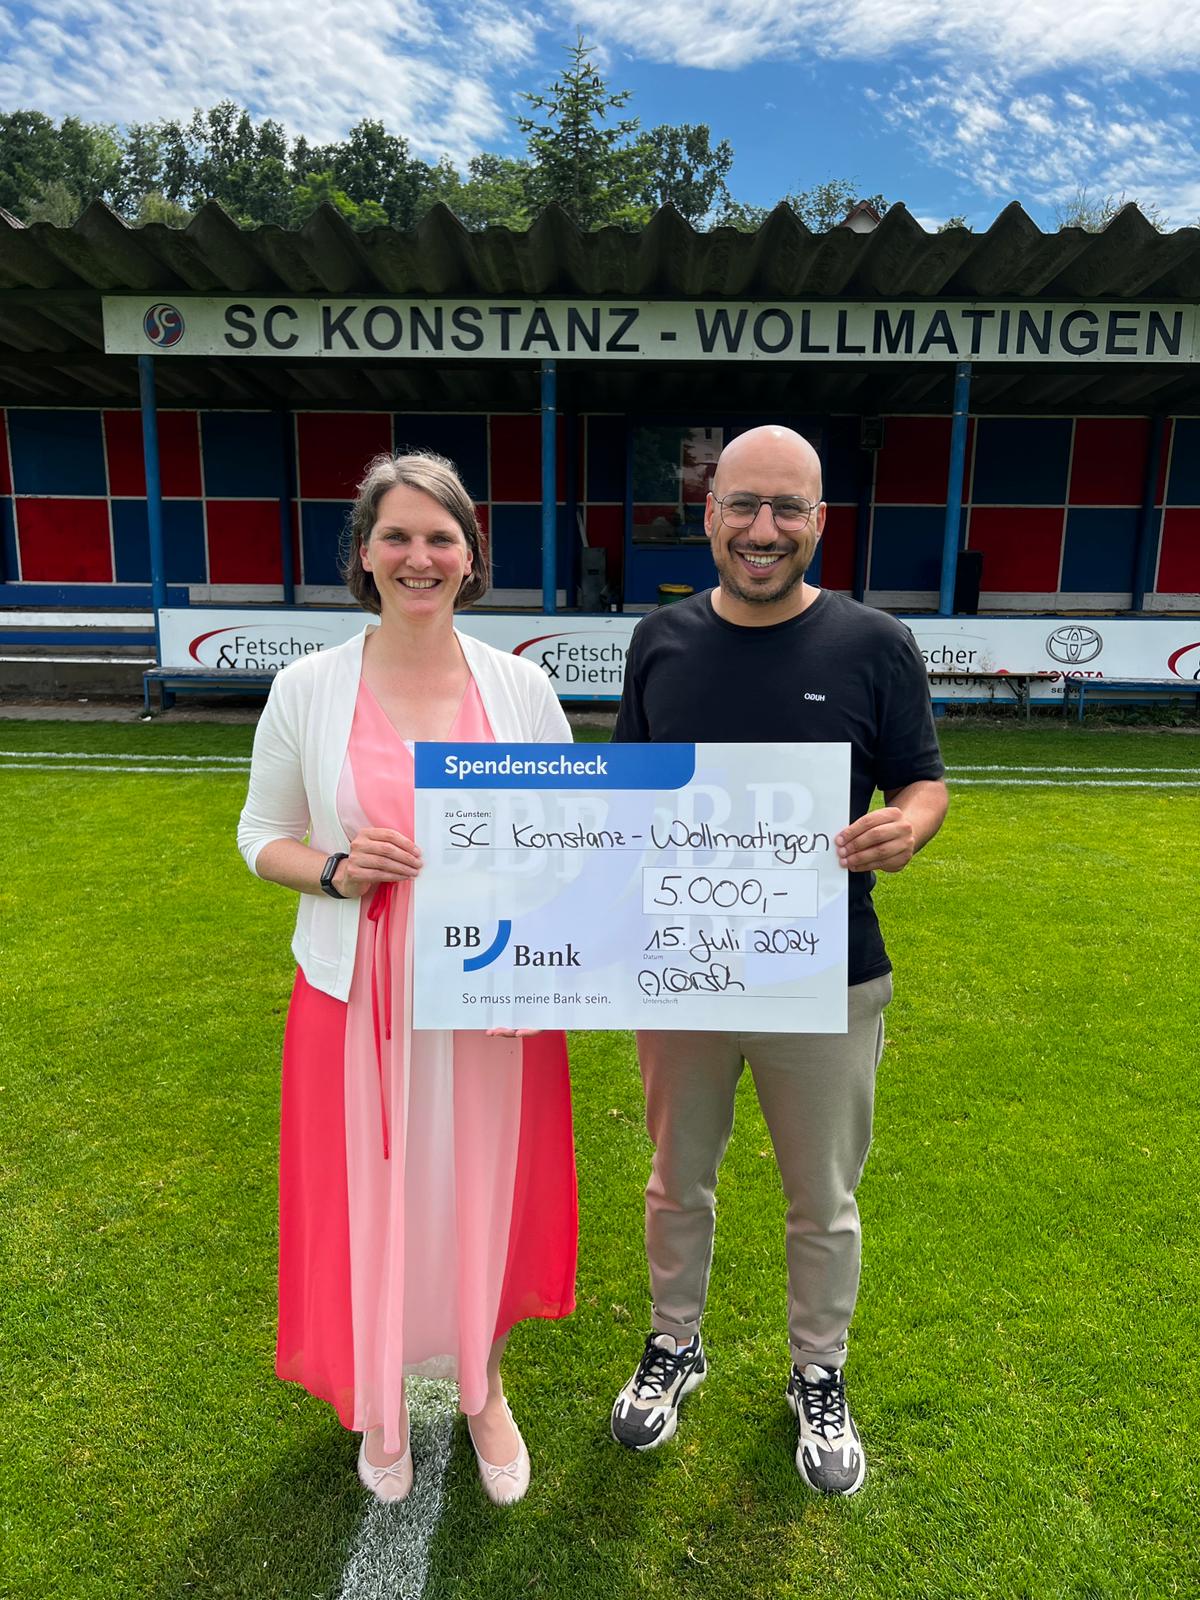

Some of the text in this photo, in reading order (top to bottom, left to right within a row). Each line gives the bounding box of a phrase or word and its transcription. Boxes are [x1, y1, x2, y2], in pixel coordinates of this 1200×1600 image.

[223, 303, 299, 350] SC
[323, 304, 641, 352] KONSTANZ
[695, 307, 1184, 356] WOLLMATINGEN
[235, 636, 324, 656] Fetscher
[557, 643, 629, 662] Fetsch
[920, 645, 977, 664] scher
[566, 665, 622, 683] Dietri
[444, 754, 608, 780] Spendenscheck
[456, 810, 492, 818] Gunsten:
[449, 823, 490, 848] SC
[513, 822, 626, 849] Konstanz
[651, 820, 830, 864] Wollmatingen
[654, 876, 788, 914] 5.000,-
[444, 926, 481, 948] BB
[645, 926, 820, 963] 15. Juli 2024
[513, 943, 582, 967] Bank
[643, 953, 664, 961] Datum
[462, 993, 612, 1004] So muss meine Bank sein.
